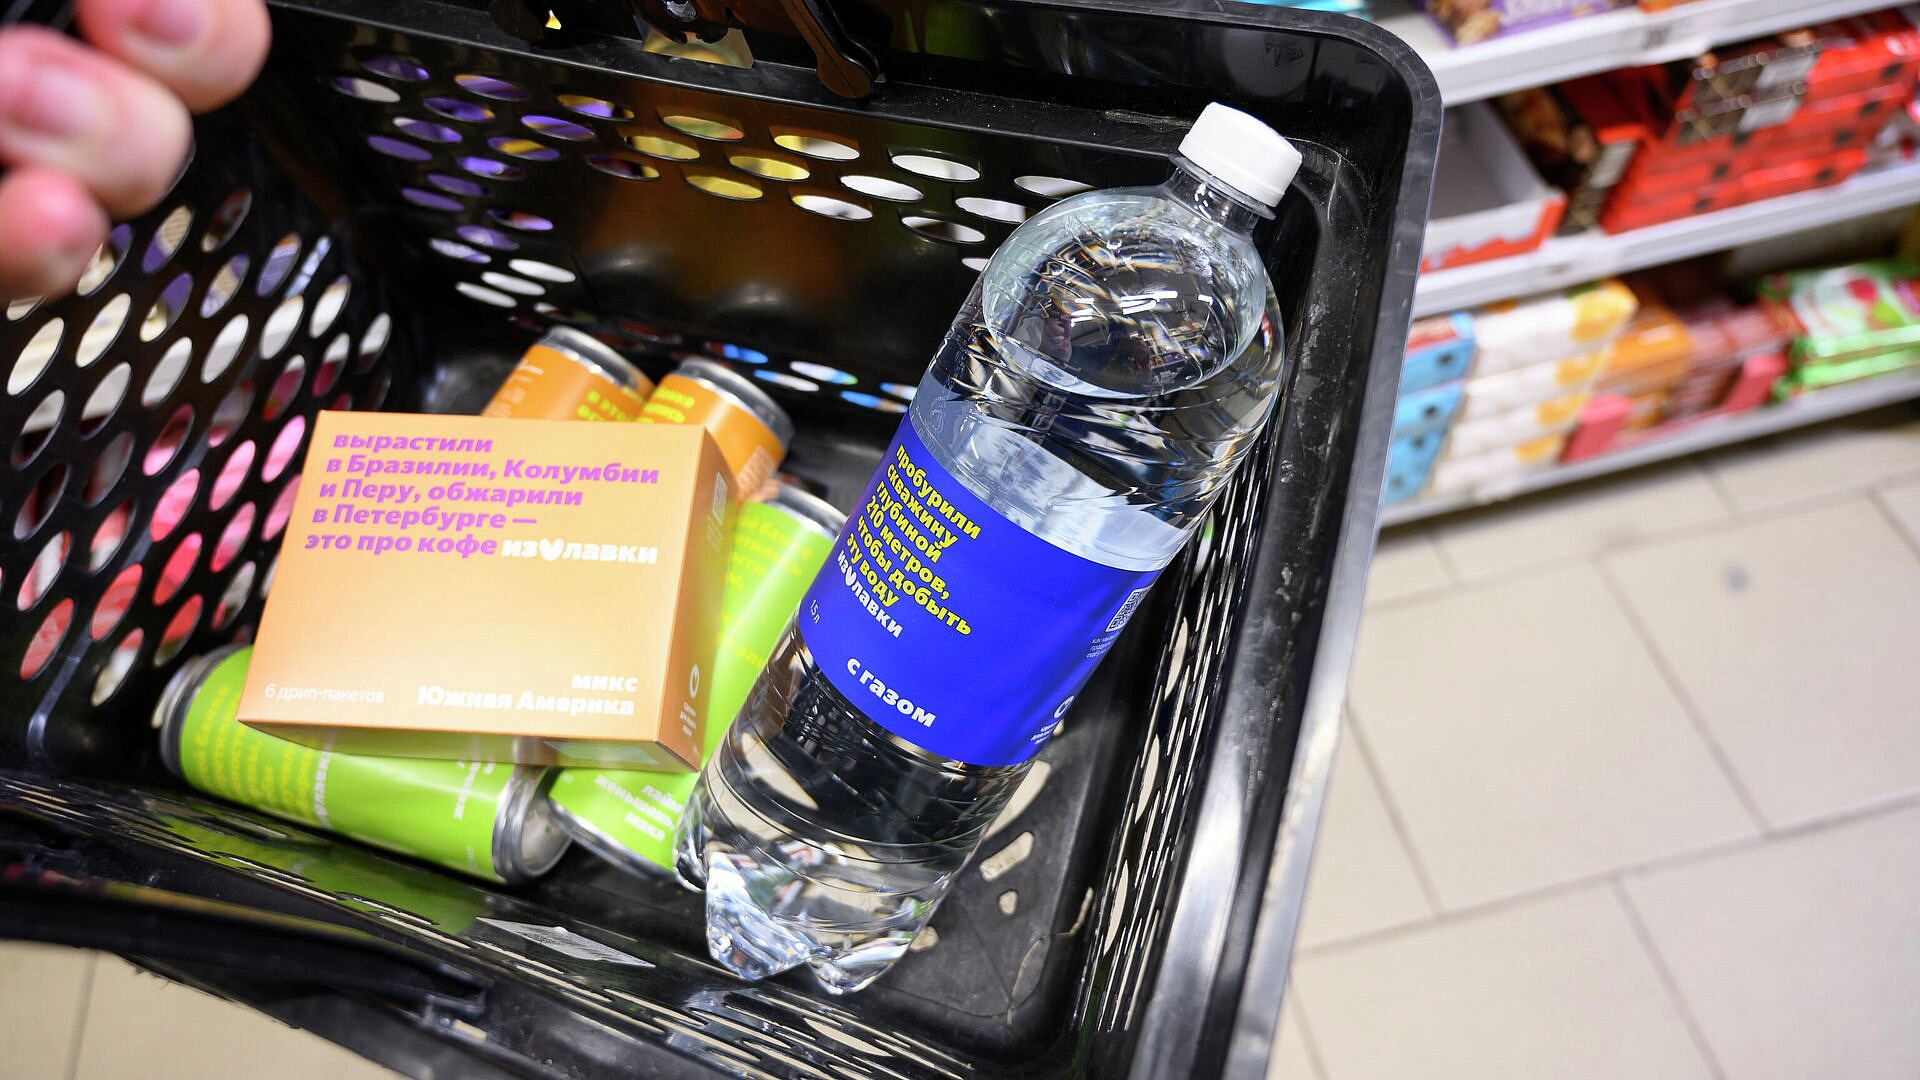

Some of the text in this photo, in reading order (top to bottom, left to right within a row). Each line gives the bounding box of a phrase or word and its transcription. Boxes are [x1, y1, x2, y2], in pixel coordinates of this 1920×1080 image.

[333, 434, 494, 454] вырастили
[326, 454, 660, 485] в Бразилии, Колумбии
[319, 478, 583, 508] и Перу, обжарили
[887, 463, 959, 549] скважину
[896, 444, 982, 540] пробурили
[312, 508, 328, 524] в
[332, 503, 507, 532] Петербурге
[876, 480, 944, 563] глубиной
[305, 534, 353, 550] это
[356, 535, 413, 556] про
[417, 533, 498, 559] кофе
[865, 494, 950, 600] 210 метров,
[846, 533, 899, 607] эту воду
[857, 515, 972, 636] чтобы добыть
[265, 685, 385, 704] 6 дрип-пакетов
[571, 673, 639, 693] микс
[847, 658, 937, 728] с газом
[416, 684, 634, 717] Южная Америка
